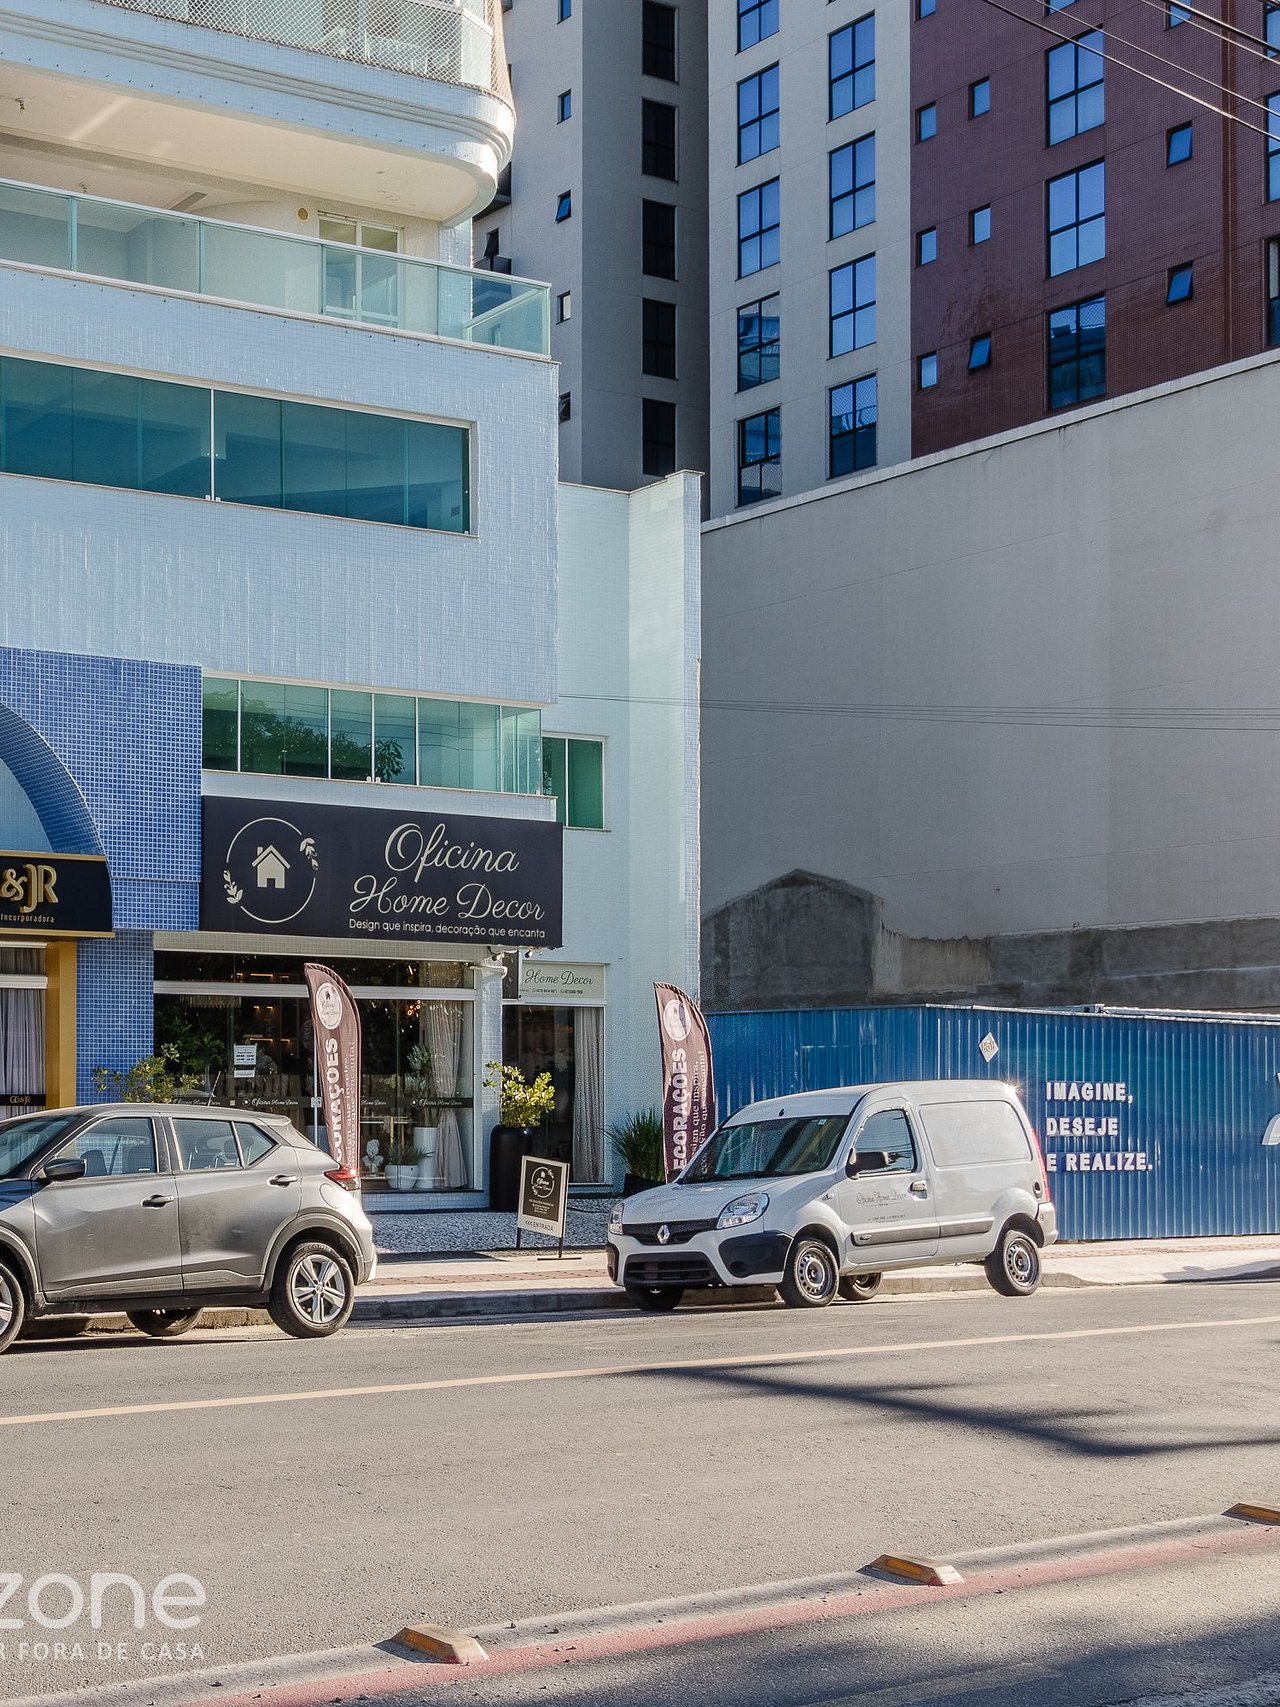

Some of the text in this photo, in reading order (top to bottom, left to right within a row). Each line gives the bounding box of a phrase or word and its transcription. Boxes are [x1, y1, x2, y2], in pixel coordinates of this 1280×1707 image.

[385, 823, 520, 882] Oficina
[349, 875, 545, 921] Home Decor
[0, 913, 55, 923] Incorporadora
[349, 918, 546, 938] Design que inspira, decoração que encanta
[524, 968, 594, 985] Home Decor
[691, 1061, 700, 1102] inspira,
[1046, 1082, 1133, 1104] IMAGINE,
[692, 1105, 700, 1126] que
[1046, 1117, 1118, 1136] DESEJE
[1046, 1152, 1153, 1171] E REALIZE.
